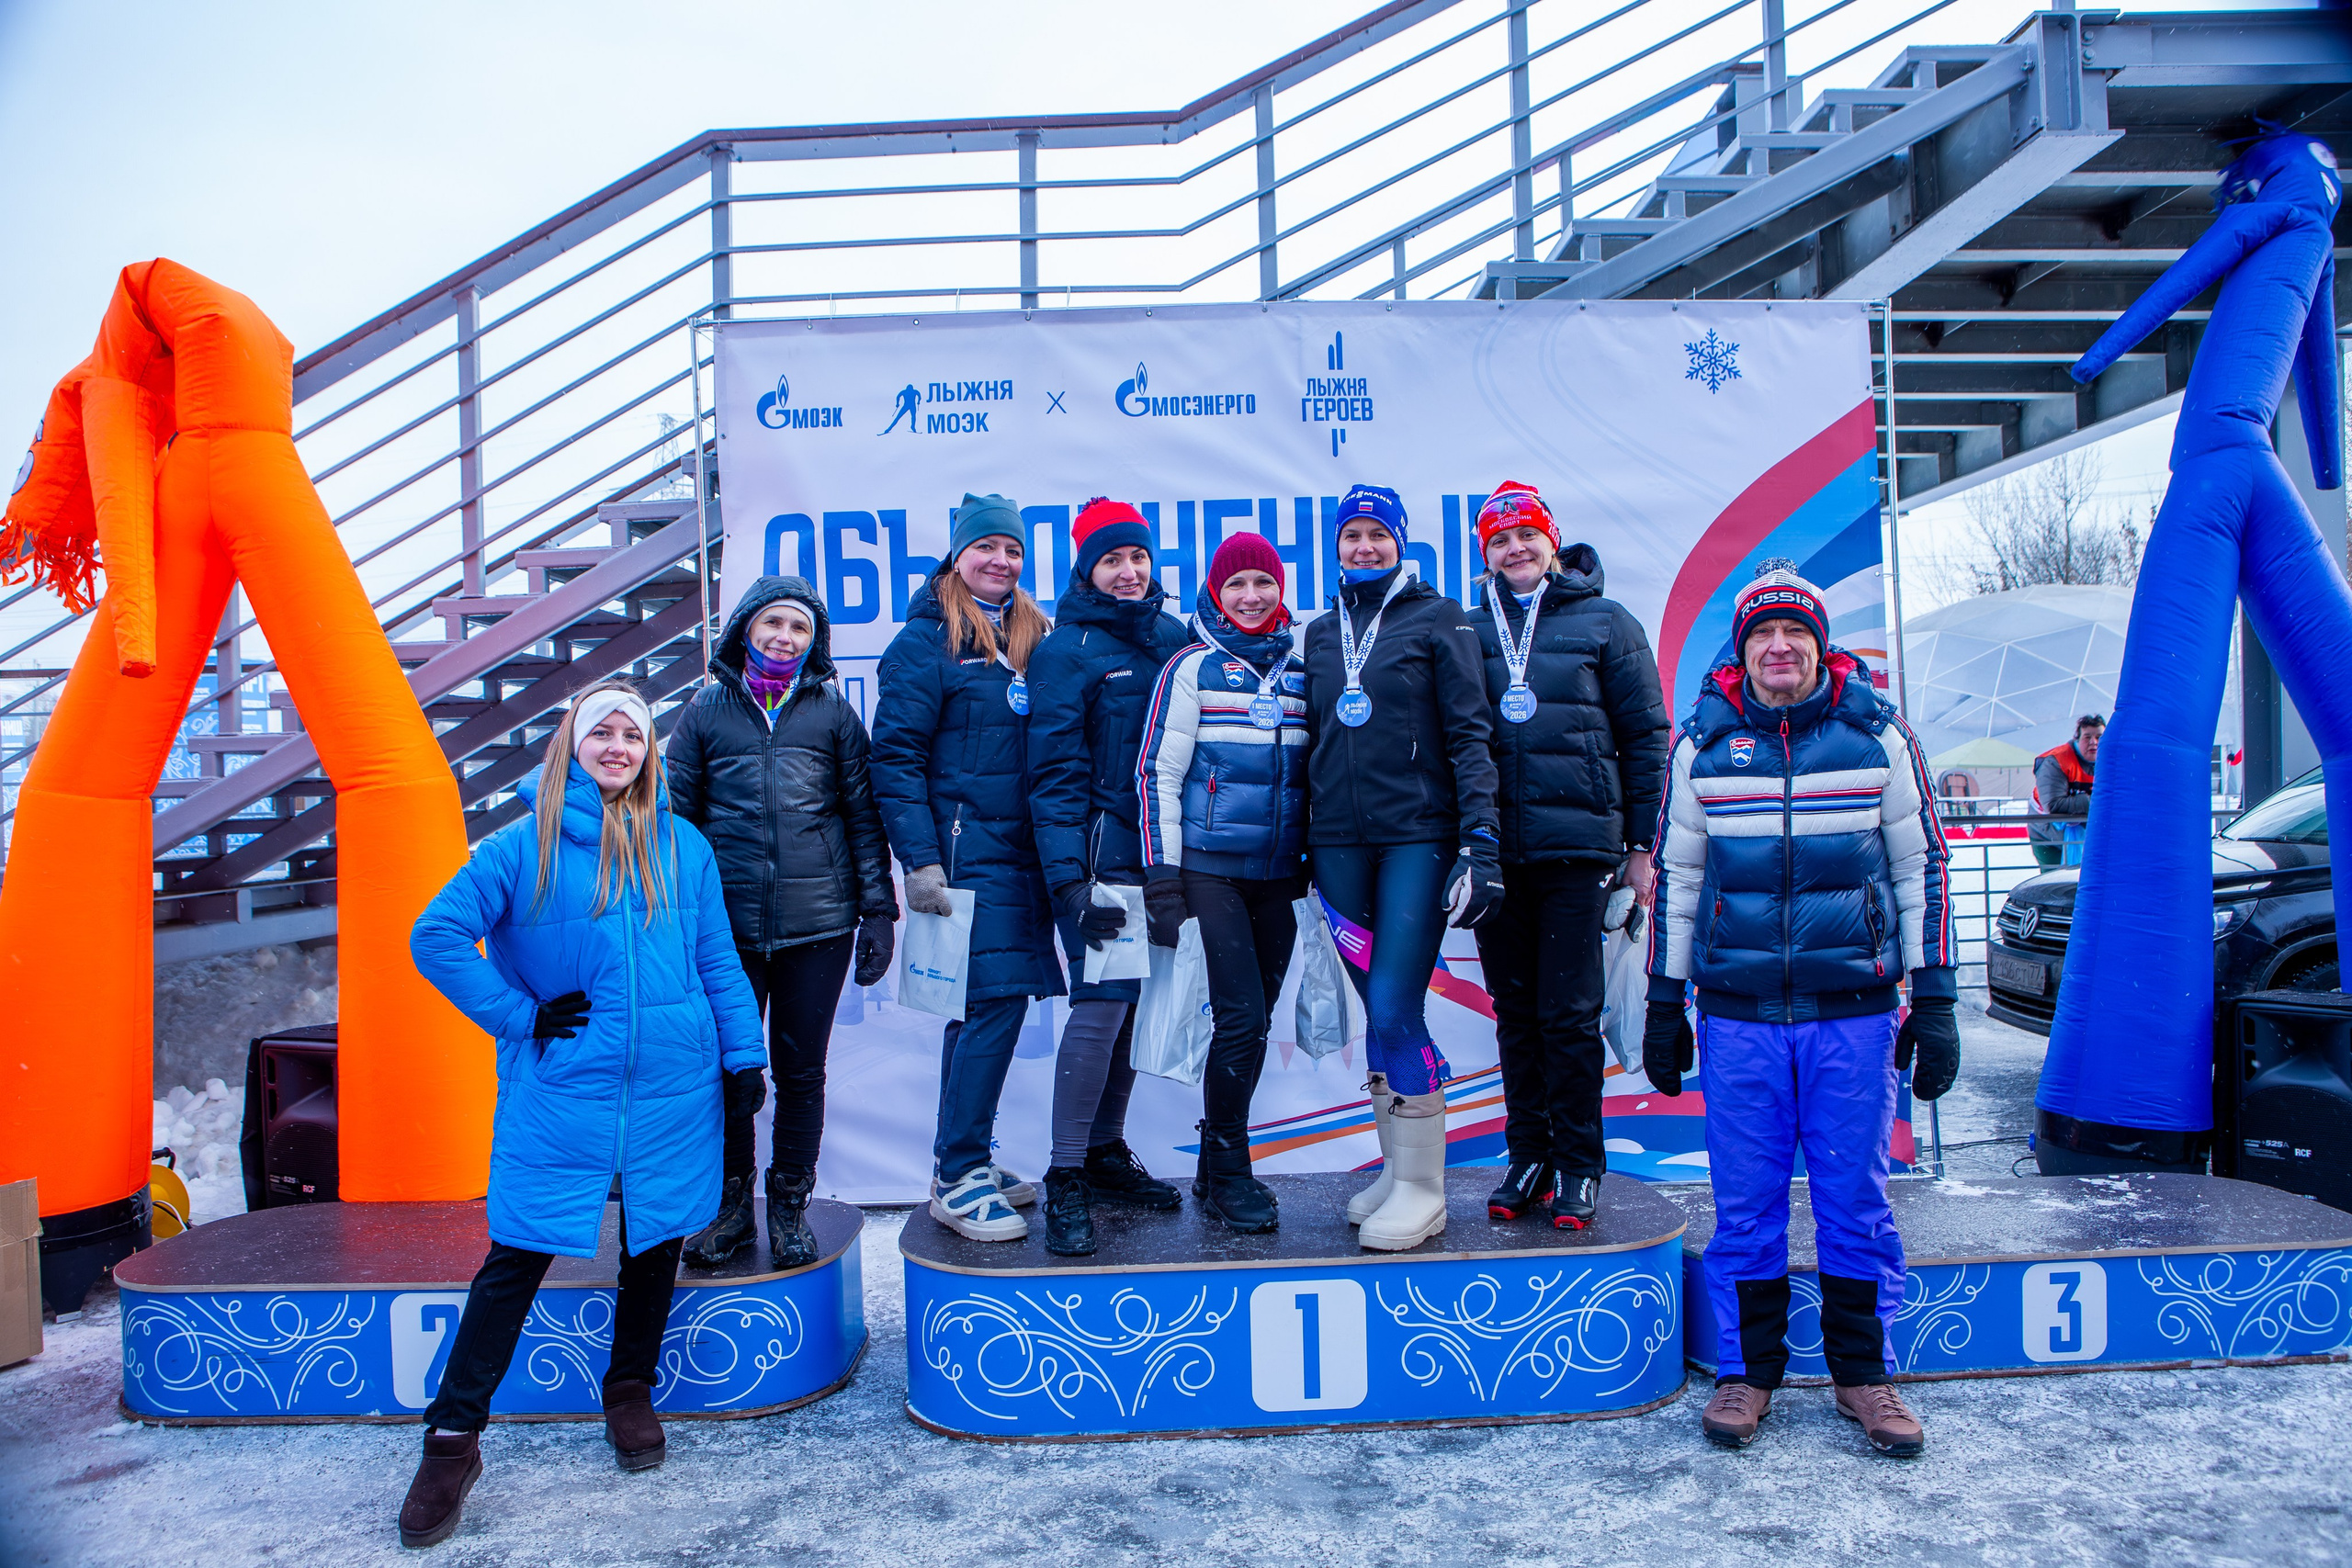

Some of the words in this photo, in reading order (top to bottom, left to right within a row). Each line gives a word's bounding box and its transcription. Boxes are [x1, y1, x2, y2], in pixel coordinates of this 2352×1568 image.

[926, 379, 1013, 403] ЛЫЖНЯ
[1306, 378, 1367, 397] ЛЫЖНЯ
[1151, 394, 1256, 417] МОСЭНЕРГО
[1301, 397, 1374, 423] ГЕРОЕВ
[792, 407, 843, 429] МОЭК
[926, 412, 989, 434] МОЭК
[1105, 670, 1133, 680] FORWARD
[1507, 694, 1525, 703] МЕСТО
[1510, 710, 1527, 720] 2026
[2294, 1147, 2312, 1158] RCF
[302, 1184, 316, 1193] RCF
[2048, 1270, 2083, 1353] 3
[420, 1303, 460, 1400] 2
[1295, 1292, 1321, 1400] 1
